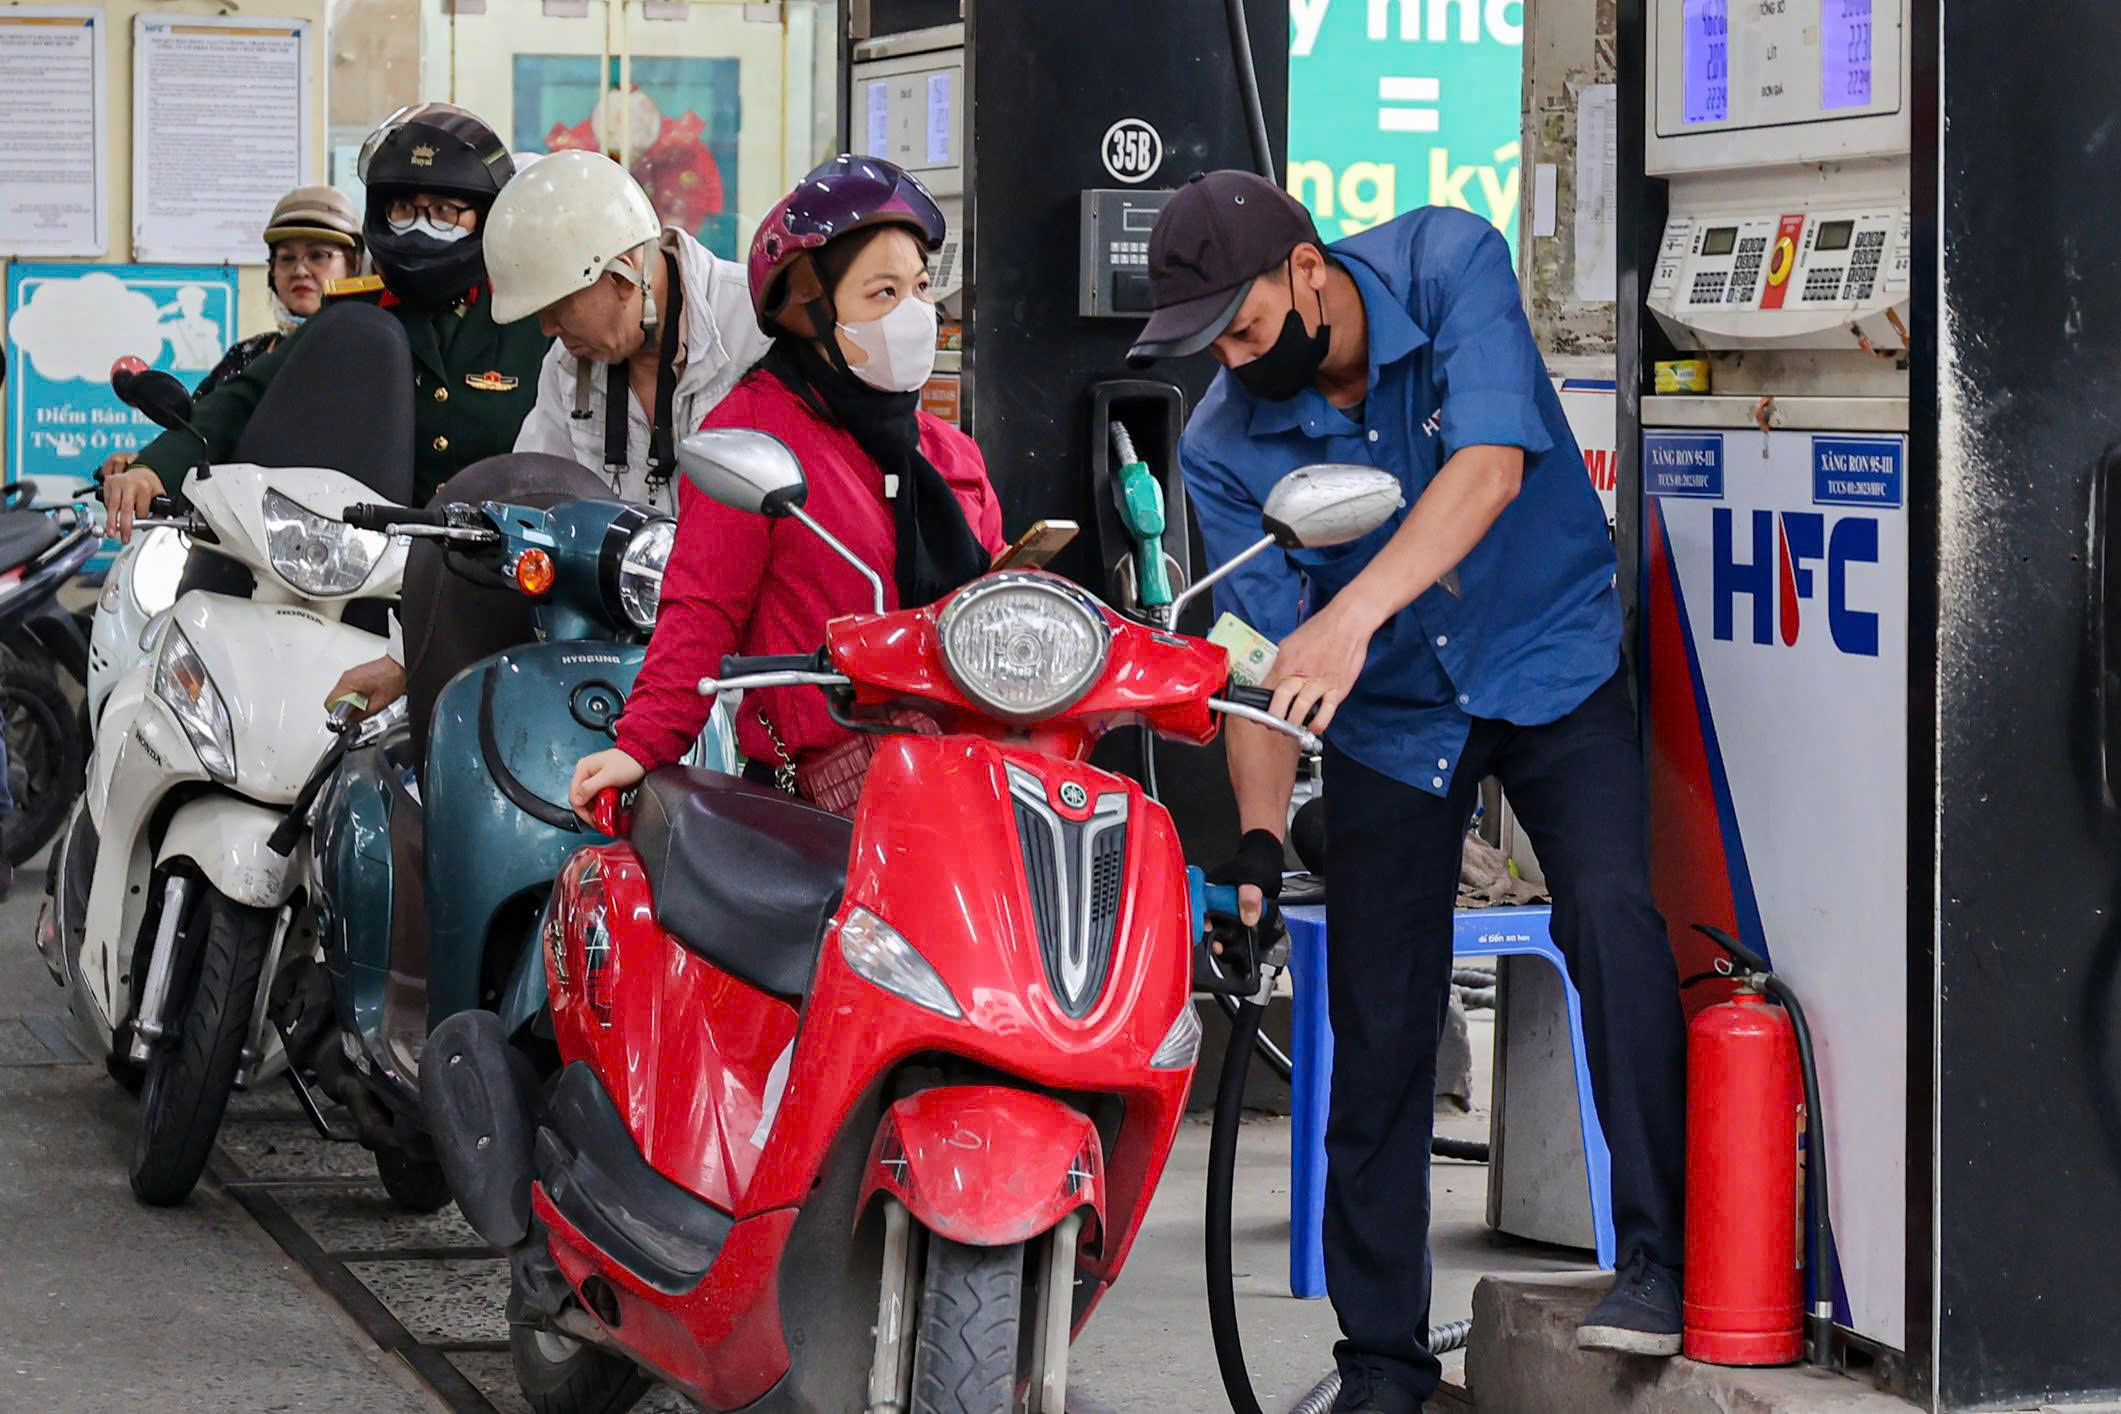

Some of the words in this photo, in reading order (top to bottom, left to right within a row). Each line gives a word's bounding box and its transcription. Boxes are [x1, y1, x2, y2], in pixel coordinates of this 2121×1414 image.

[1112, 129, 1151, 171] 35B
[1429, 140, 1520, 236] ký
[91, 406, 127, 425] Bán
[1652, 446, 1675, 465] XĂNG
[1676, 449, 1694, 466] RON
[1695, 449, 1715, 467] 95-III
[1821, 451, 1847, 472] XĂNG
[1848, 454, 1869, 472] RON
[1870, 456, 1893, 474] 95-III
[1712, 507, 1879, 657] HFC
